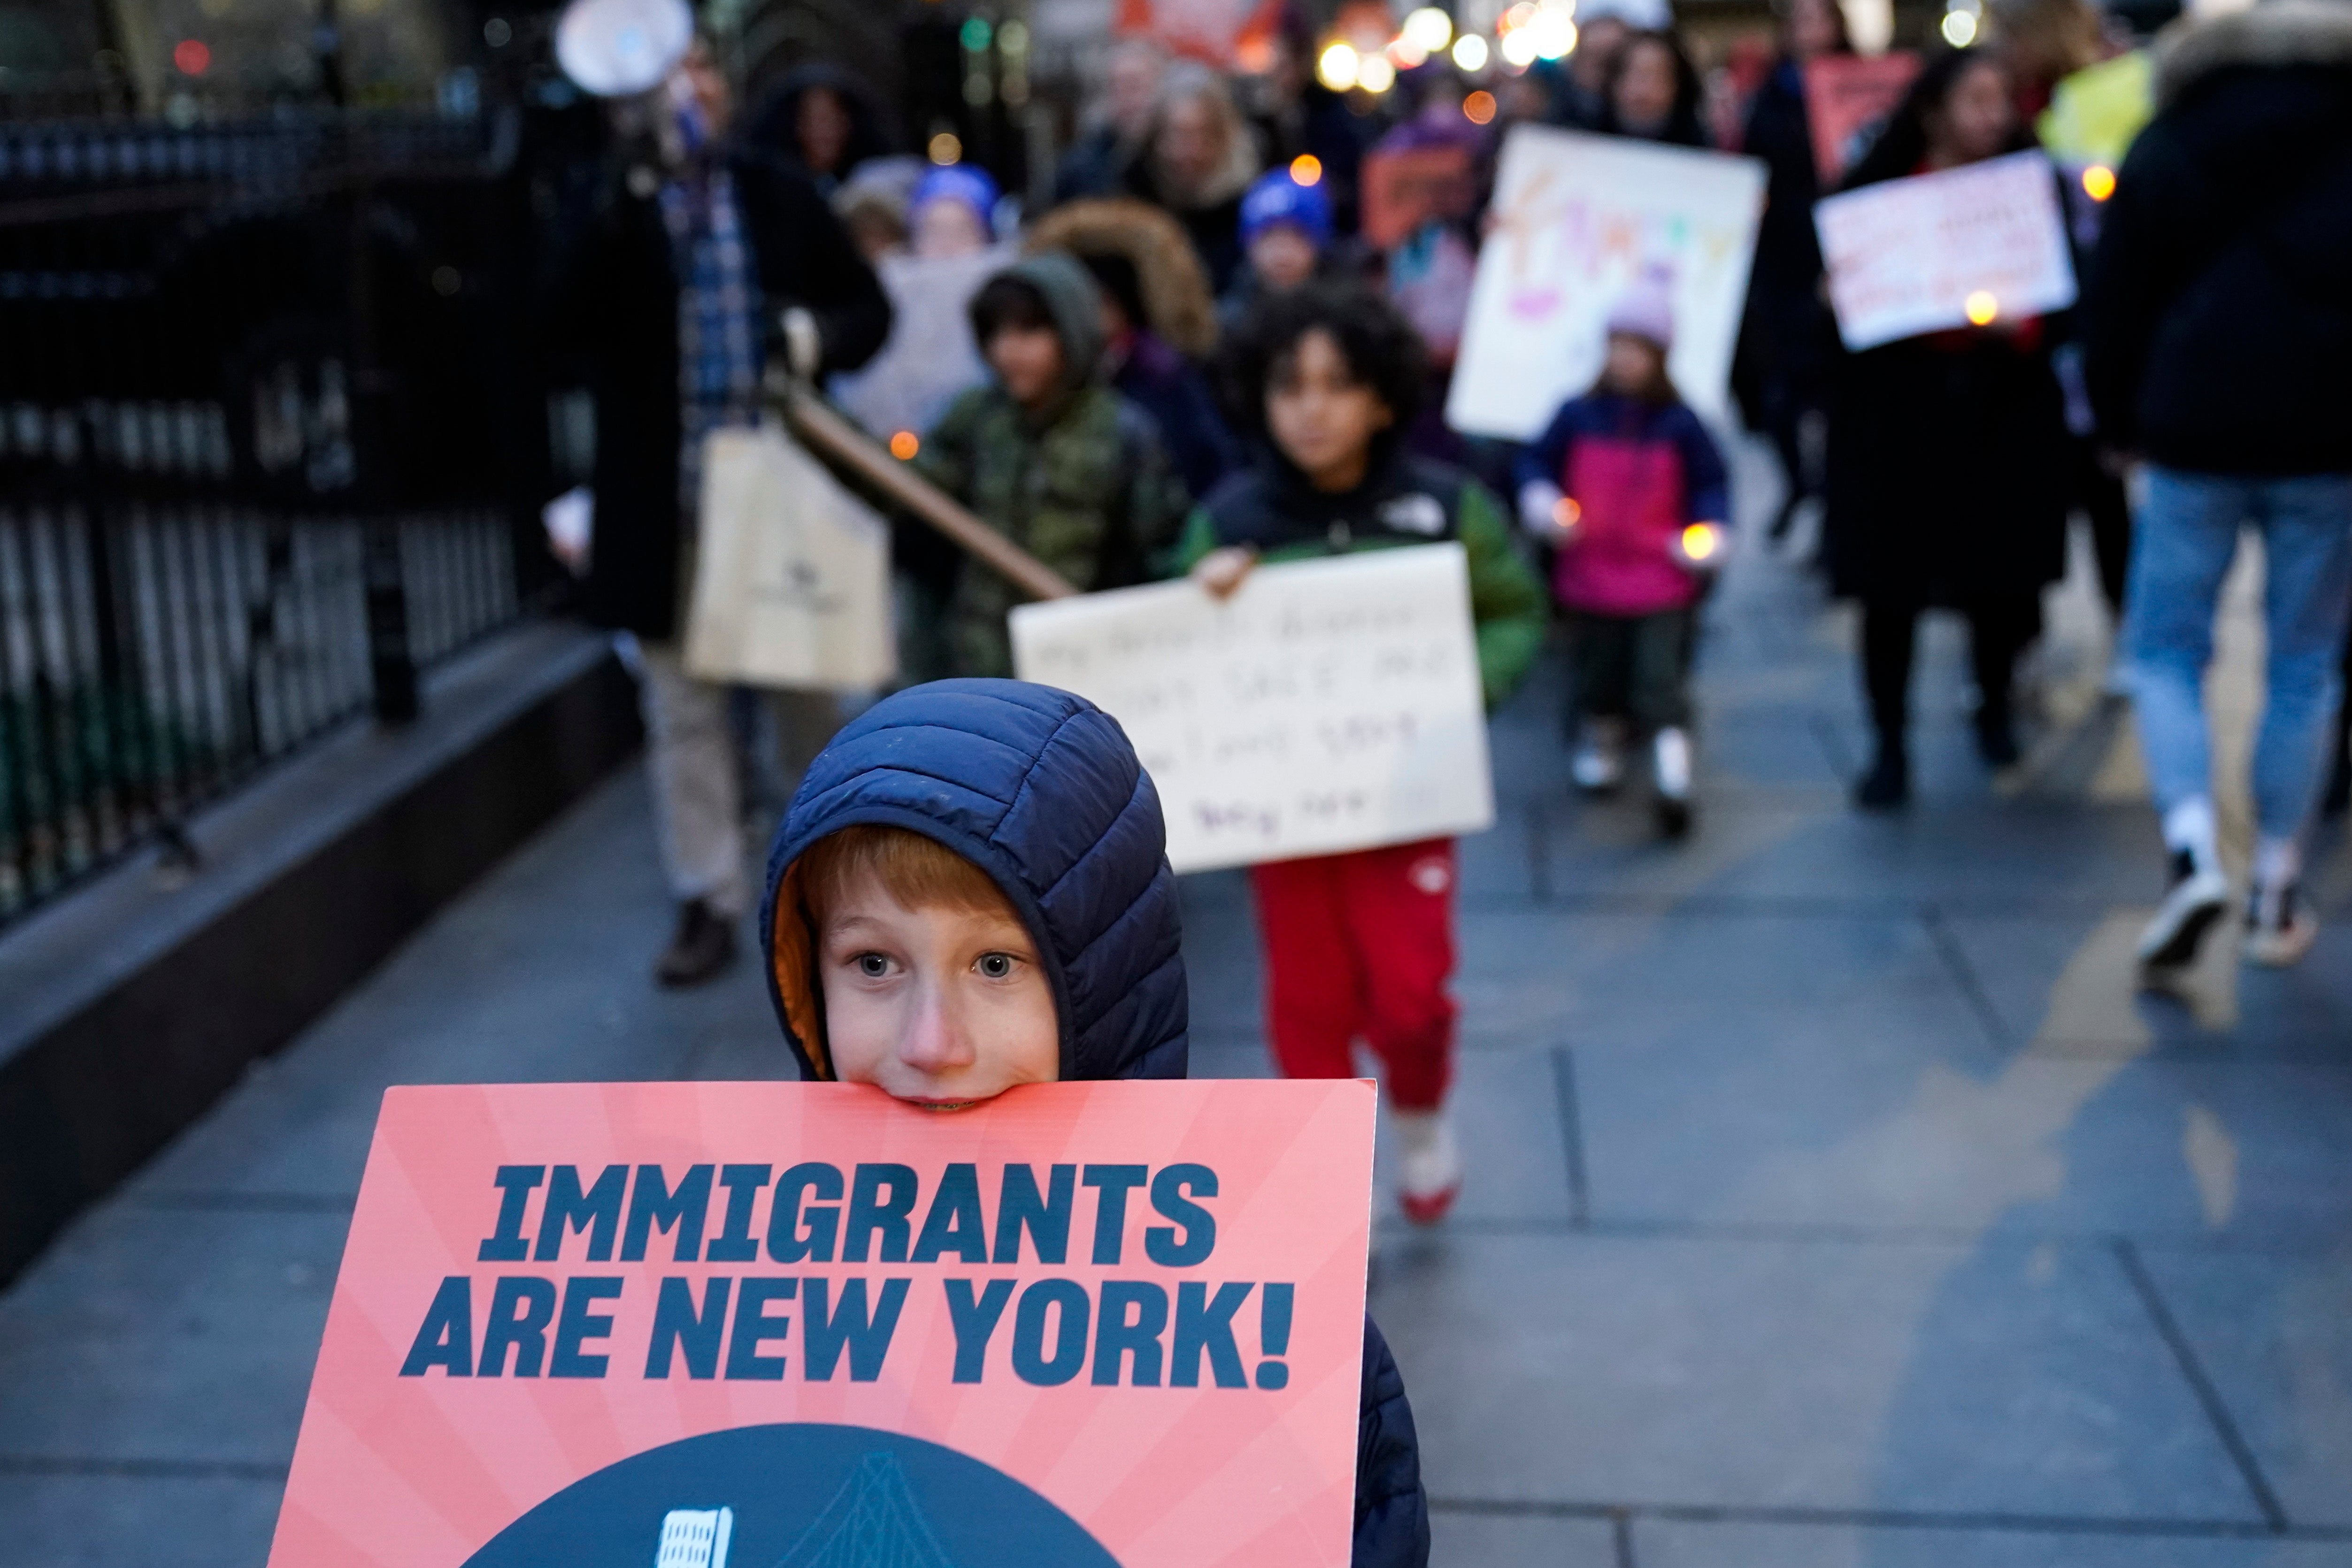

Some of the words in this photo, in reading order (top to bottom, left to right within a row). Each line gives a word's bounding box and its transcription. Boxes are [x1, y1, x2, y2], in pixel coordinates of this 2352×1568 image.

[477, 1162, 1218, 1267] IMMIGRANTS
[399, 1276, 624, 1379] ARE
[644, 1277, 912, 1382] NEW
[944, 1278, 1294, 1390] YORK!
